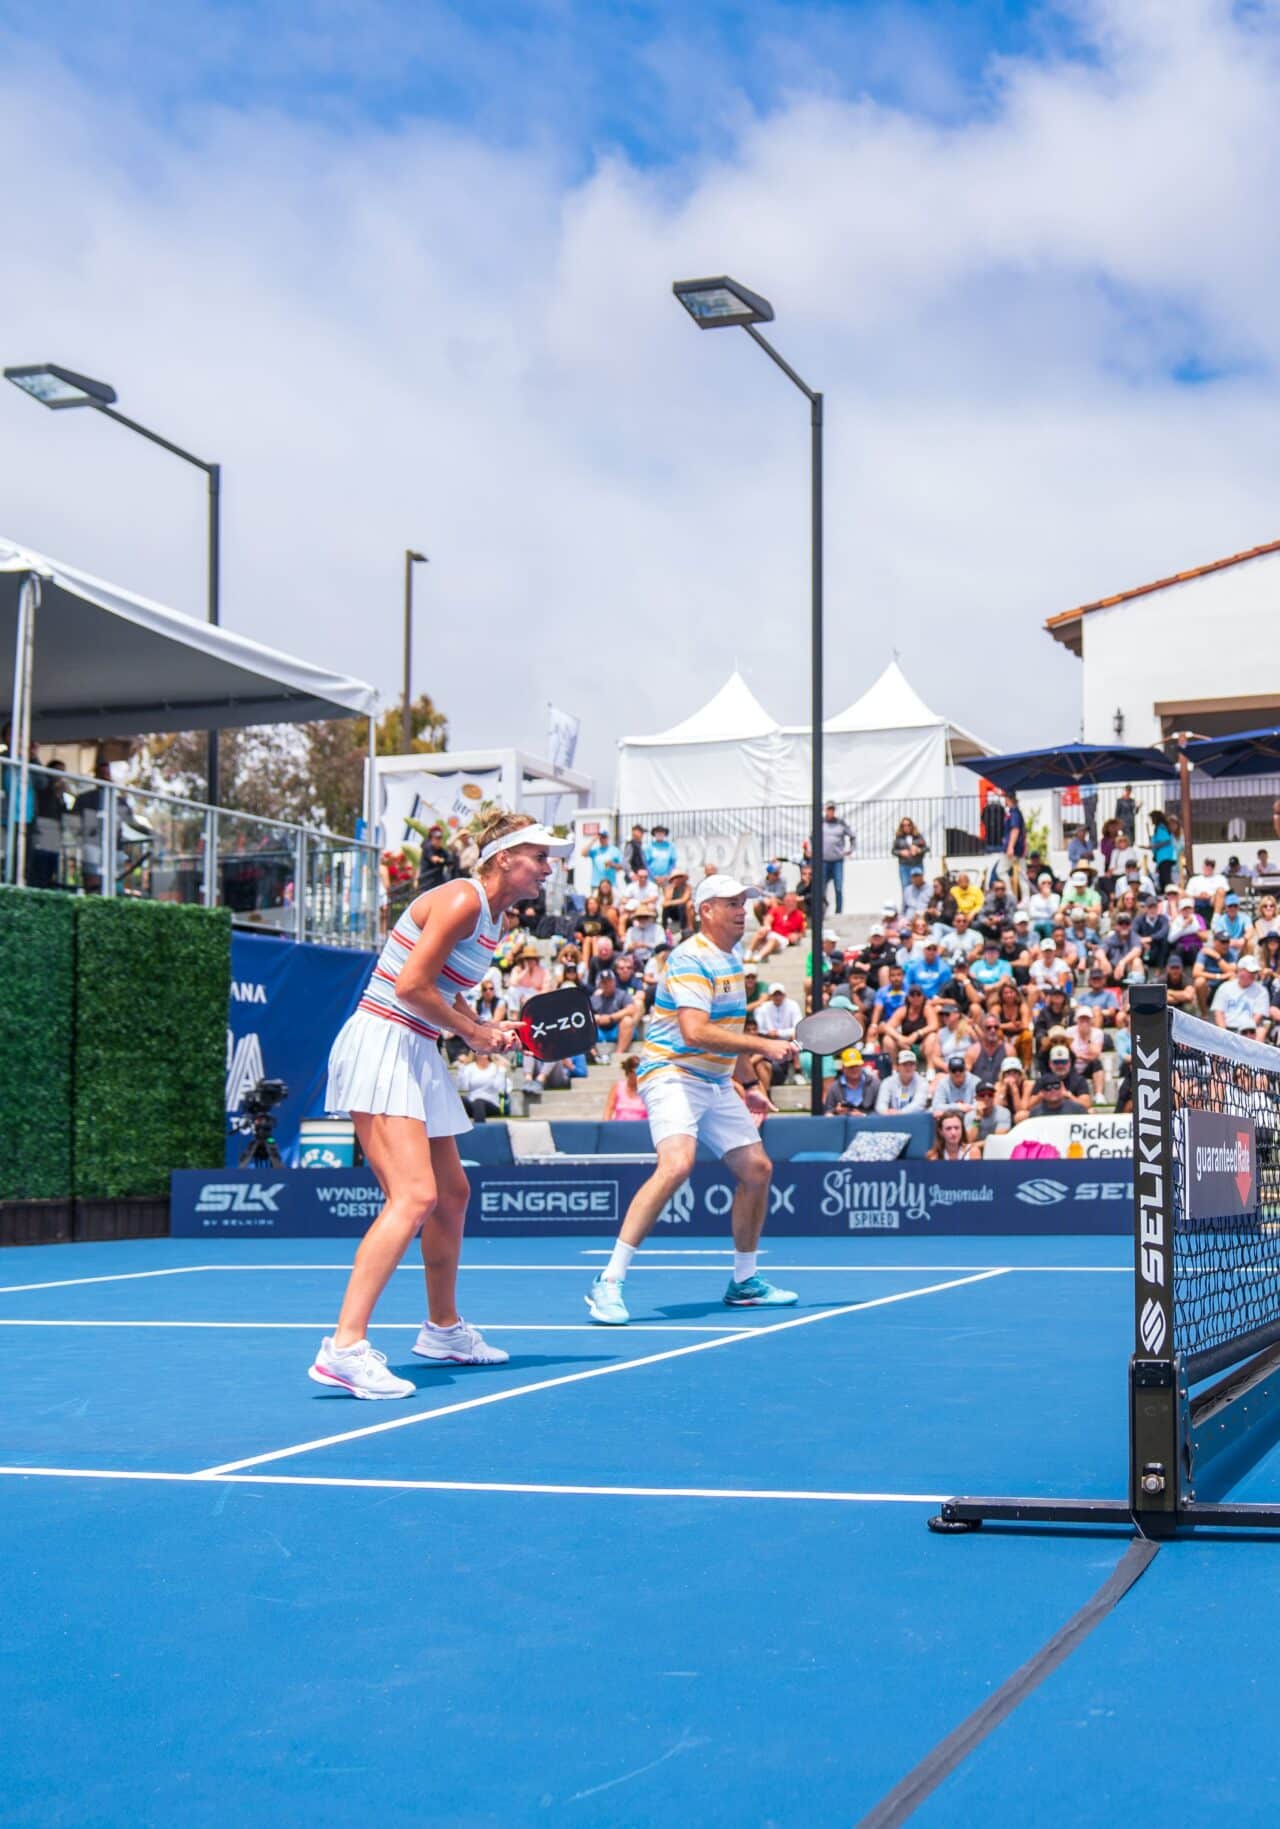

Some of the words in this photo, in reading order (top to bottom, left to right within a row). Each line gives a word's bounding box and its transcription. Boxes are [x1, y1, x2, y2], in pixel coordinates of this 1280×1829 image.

[481, 1190, 610, 1213] ENGAGE
[821, 1168, 931, 1220] Simply
[929, 1184, 993, 1206] Lemonade
[855, 1213, 894, 1226] SPIKED
